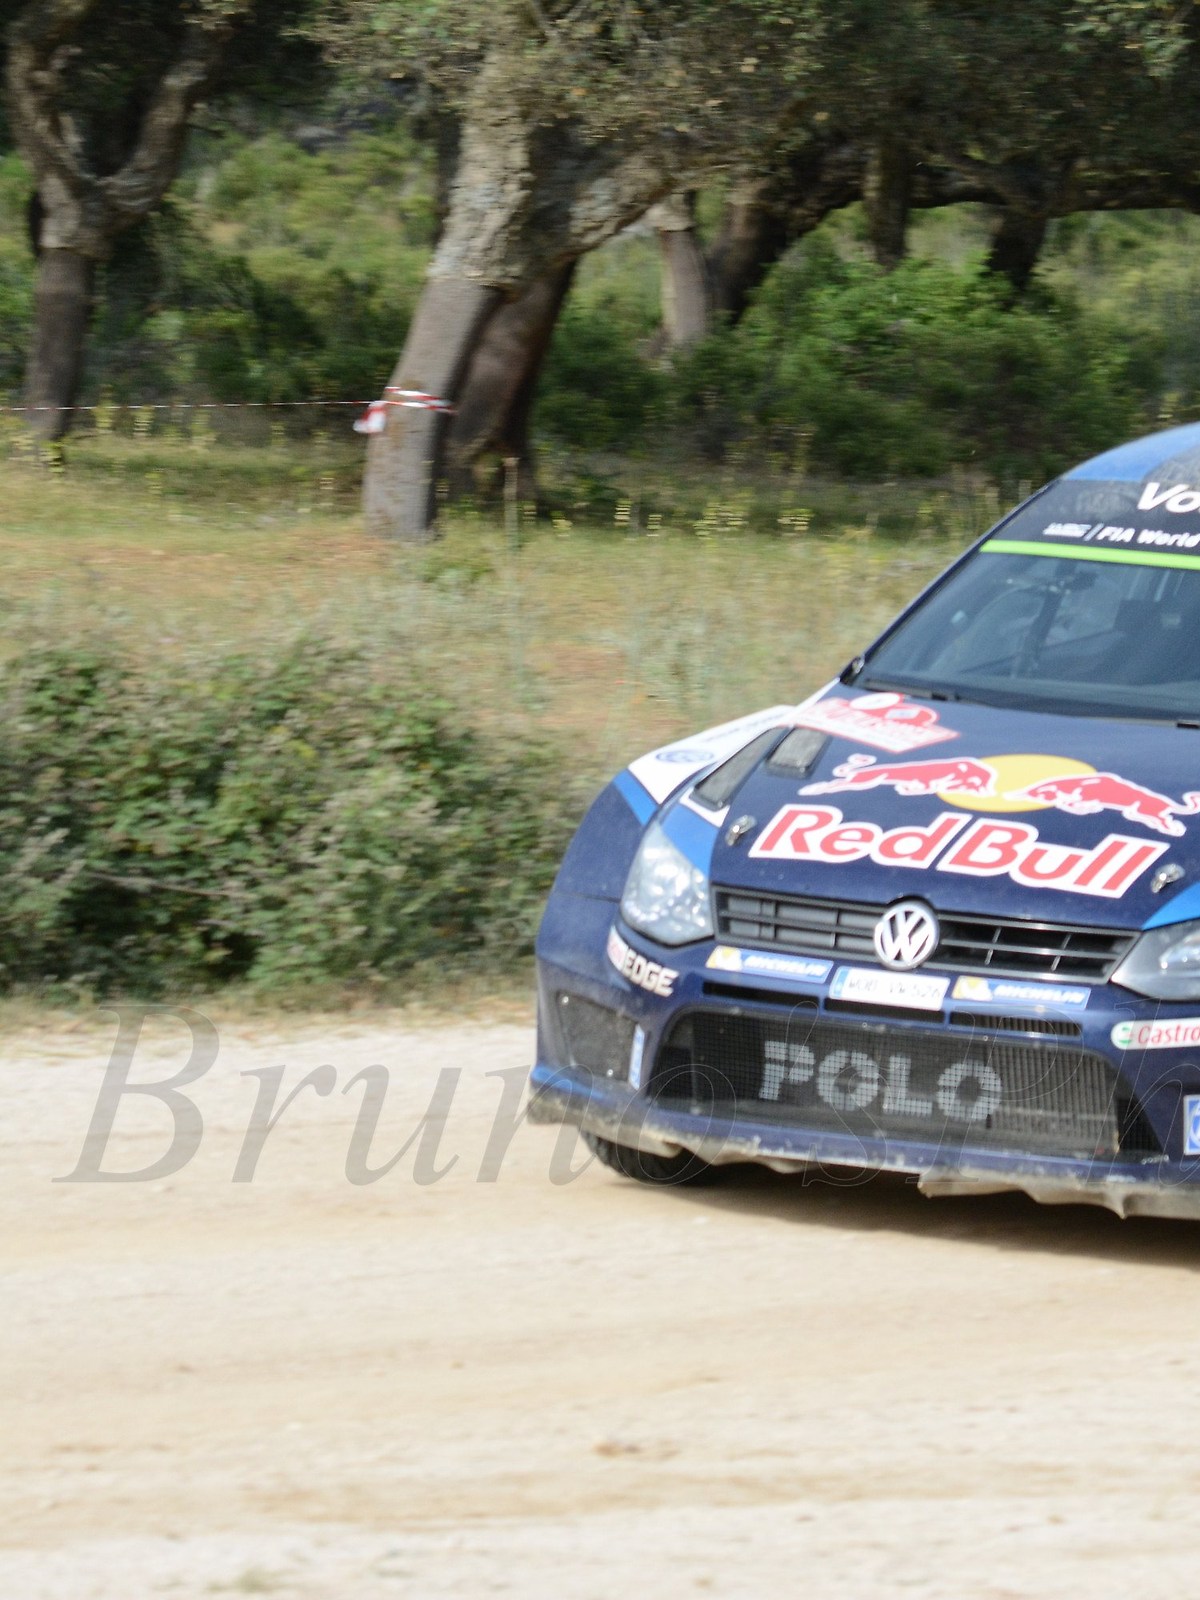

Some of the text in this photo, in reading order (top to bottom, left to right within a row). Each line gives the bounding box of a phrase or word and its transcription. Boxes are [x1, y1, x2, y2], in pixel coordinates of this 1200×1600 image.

[1097, 526, 1136, 543] FIA
[751, 805, 1169, 898] Red Bull
[873, 903, 939, 970] VW
[622, 947, 679, 997] EDGE
[758, 1040, 1002, 1123] POLO
